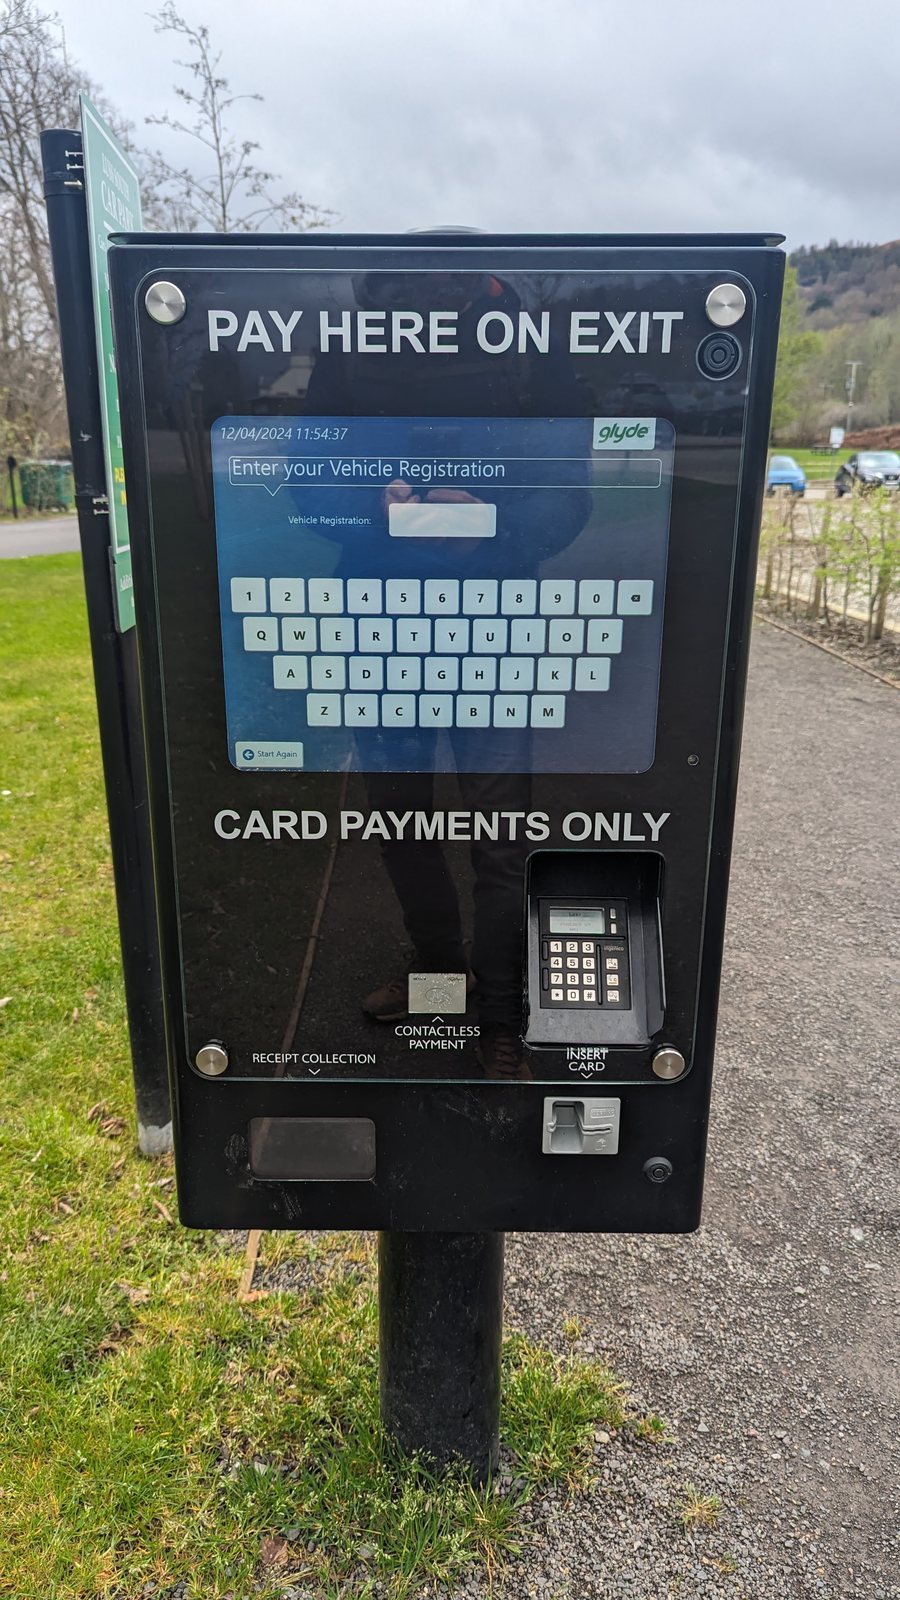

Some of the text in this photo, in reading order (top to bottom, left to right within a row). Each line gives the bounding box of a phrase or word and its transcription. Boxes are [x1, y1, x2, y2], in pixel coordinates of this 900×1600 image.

[207, 310, 684, 354] PAY HERE ON EXIT
[221, 427, 348, 441] 12/04/2024 11:54:37
[598, 422, 650, 444] glyde
[232, 459, 506, 482] Enter your Vehicle Registration
[287, 515, 372, 527] Vehicle Registration:
[284, 591, 291, 602] 2
[323, 592, 330, 602] 3
[361, 592, 369, 603] 4
[400, 592, 407, 603] 5
[438, 593, 446, 603] 6
[477, 593, 485, 604] 7
[515, 593, 523, 604] 8
[554, 593, 562, 604] 9
[592, 593, 601, 604] 0
[256, 630, 266, 641] Q
[293, 630, 306, 641] W
[335, 631, 342, 641] E
[372, 631, 380, 642] R
[410, 631, 418, 642] T
[448, 632, 456, 642] Y
[486, 632, 495, 642] U
[562, 632, 572, 642] O
[601, 632, 610, 642] P
[286, 668, 597, 681] A S D F G H J K L
[320, 706, 554, 717] Z X C V B N M
[257, 750, 298, 760] Start Again
[214, 809, 671, 842] CARD PAYMENTS ONLY
[394, 1025, 481, 1037] CONTACTLESS
[409, 1039, 467, 1050] PAYMENT
[252, 1053, 376, 1064] RECEIPT COLLECTION
[566, 1047, 609, 1060] INSERT
[568, 1061, 606, 1072] CARD
